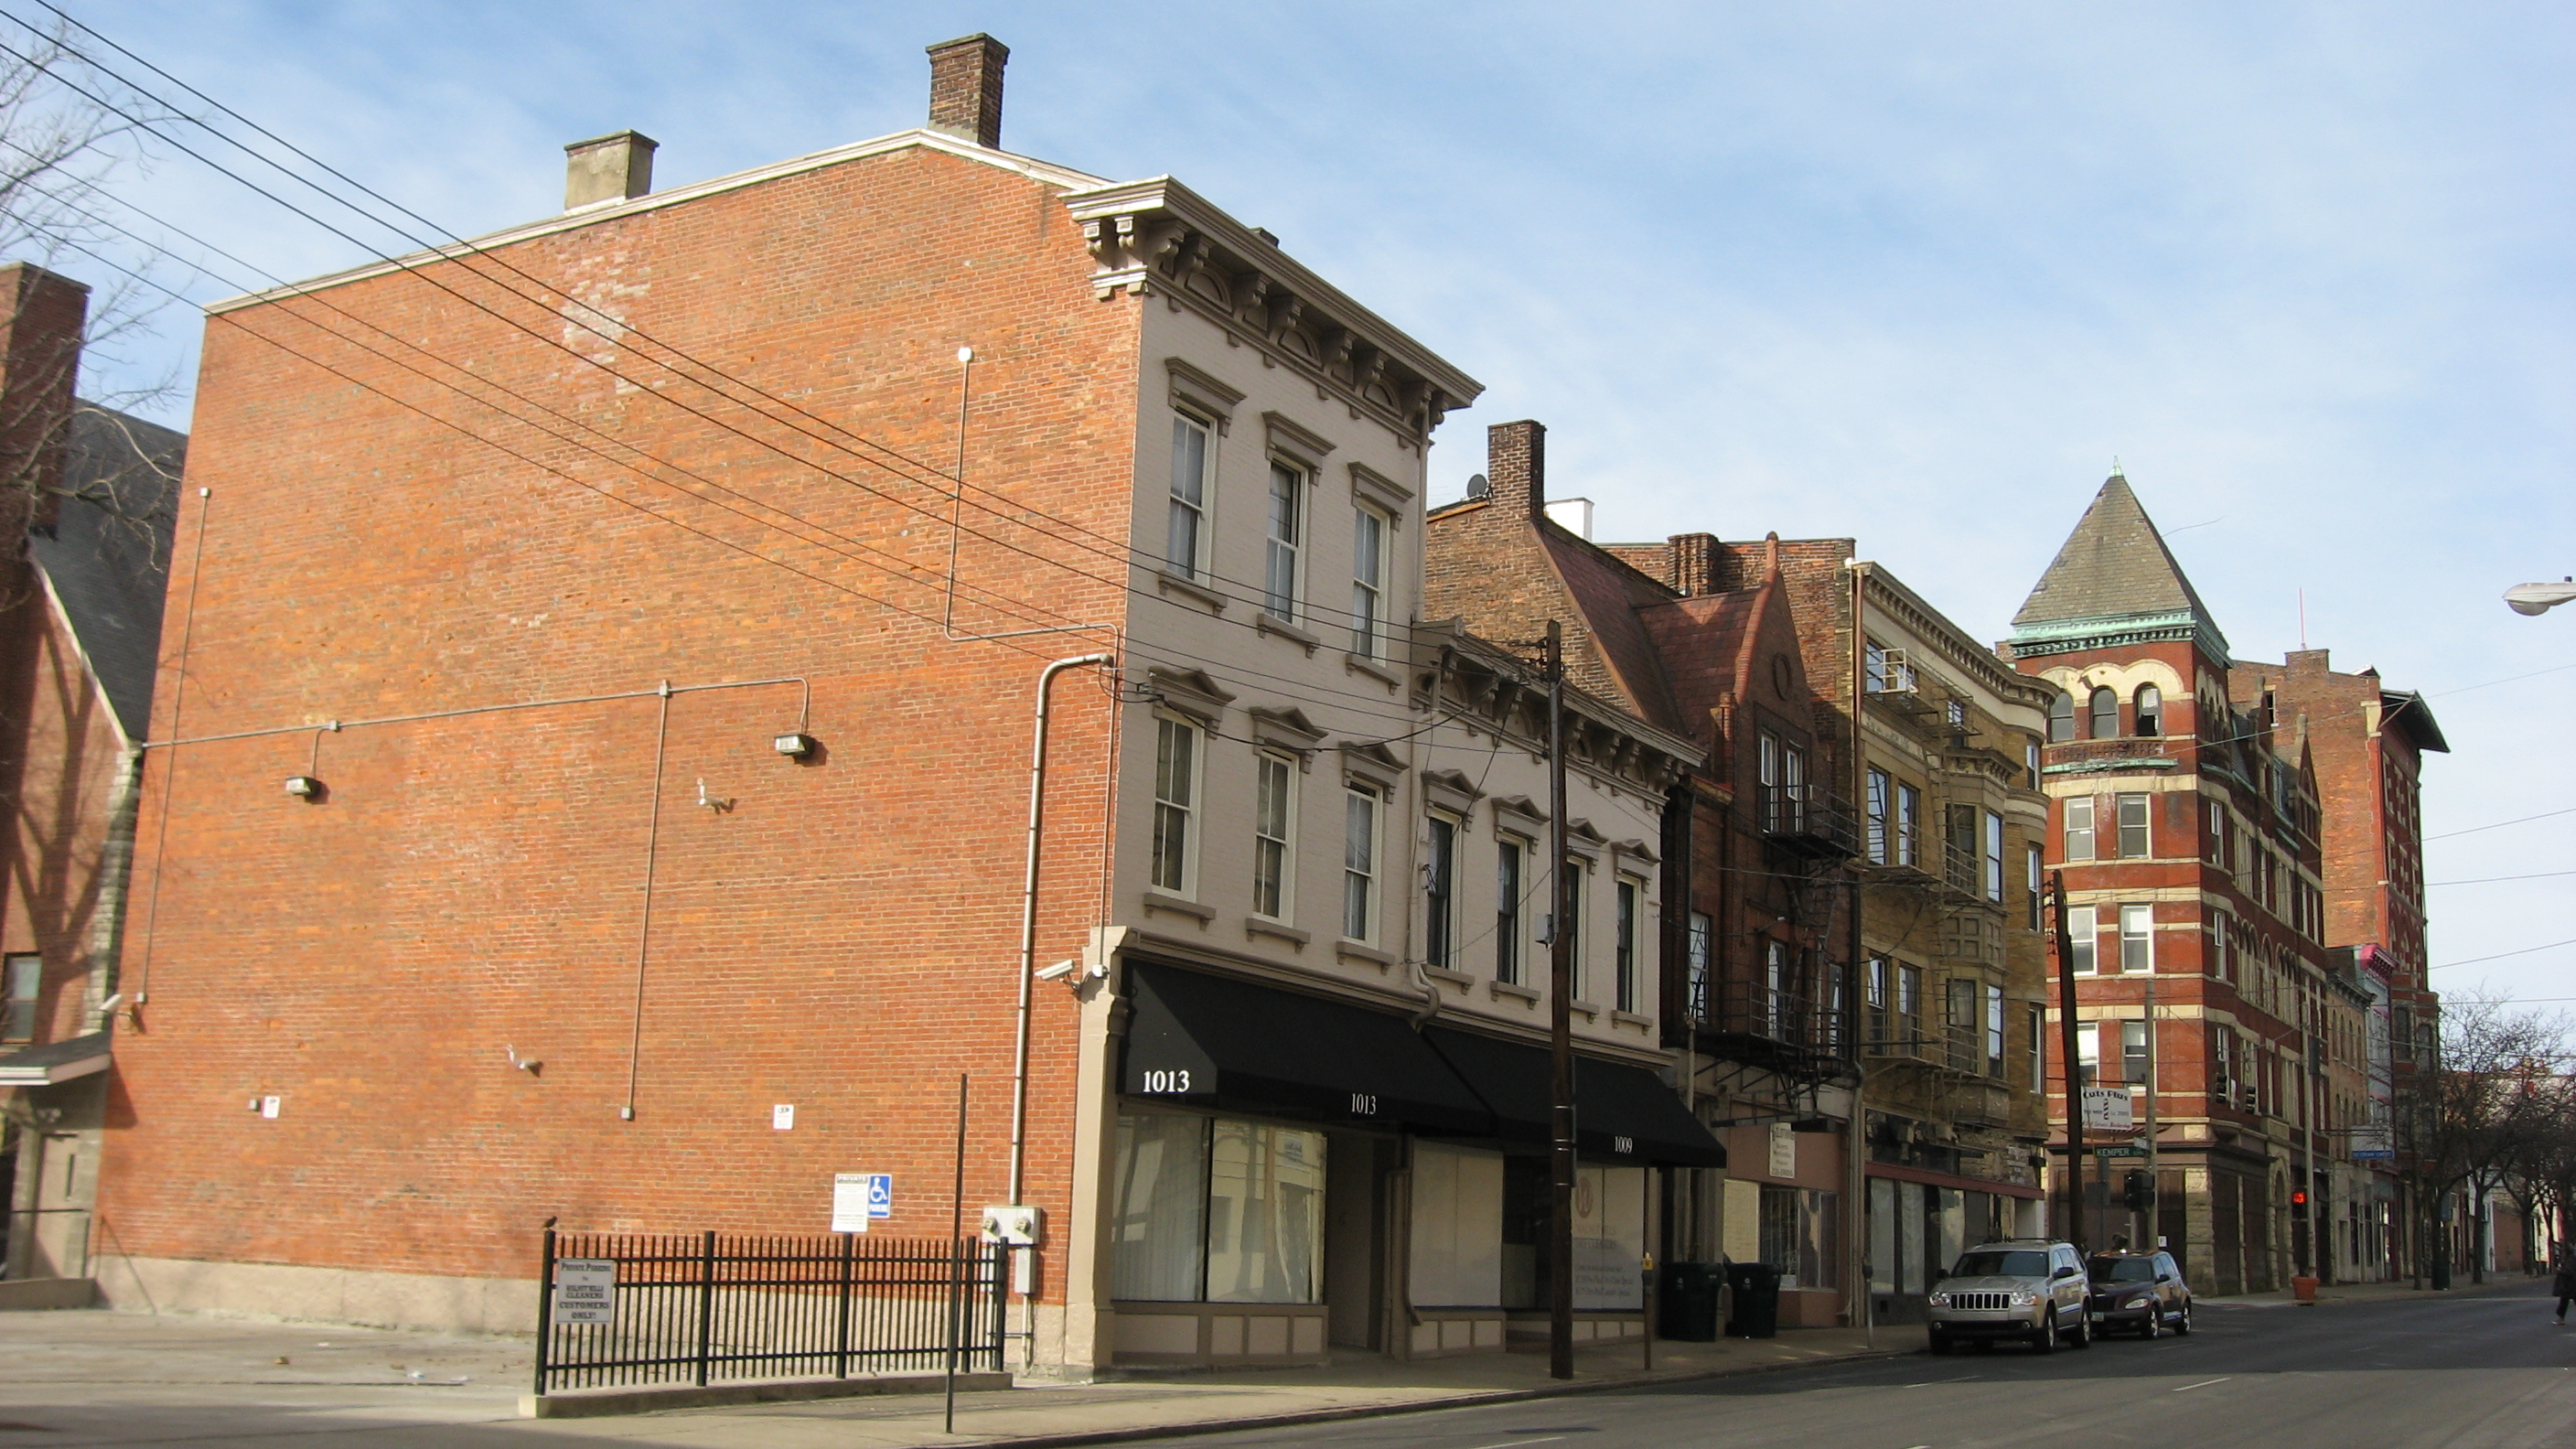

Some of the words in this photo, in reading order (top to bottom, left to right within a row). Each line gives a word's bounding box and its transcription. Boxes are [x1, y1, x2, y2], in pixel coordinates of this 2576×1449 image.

[1143, 1070, 1190, 1092] 1013
[1351, 1093, 1377, 1114] 1013
[2083, 1090, 2104, 1099] Cuts
[2108, 1090, 2128, 1100] Plus
[1615, 1136, 1633, 1153] 1009
[2097, 1148, 2130, 1156] KEMPER
